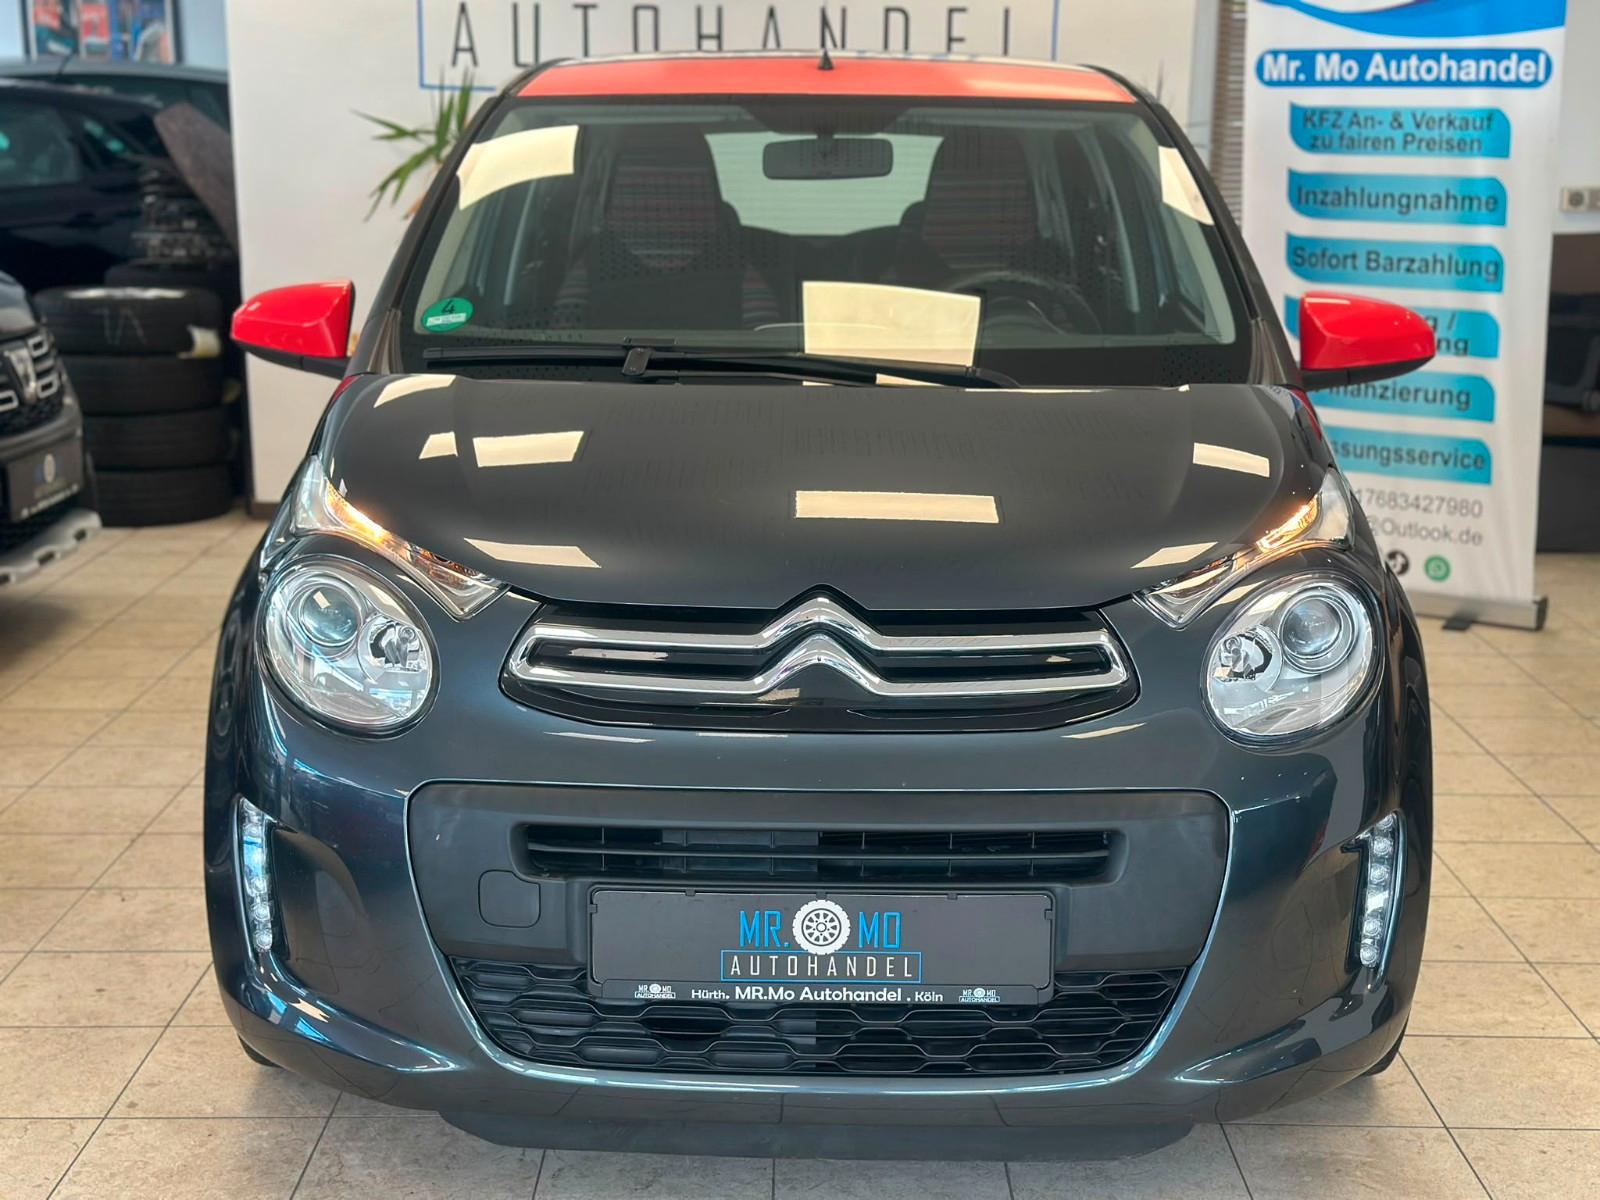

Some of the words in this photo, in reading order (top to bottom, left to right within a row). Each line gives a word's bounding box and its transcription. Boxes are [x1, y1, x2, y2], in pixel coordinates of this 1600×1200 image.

[1262, 53, 1305, 82] Mr.
[1314, 53, 1360, 82] Mo
[1365, 52, 1547, 82] Autohandel
[1303, 111, 1344, 130] KFZ
[1349, 112, 1383, 131] An-
[1390, 112, 1404, 131] &
[1411, 111, 1494, 132] Verkauf
[1310, 136, 1333, 150] zu
[1338, 131, 1396, 151] fairen
[1402, 132, 1483, 153] Preisen
[1297, 185, 1499, 215] Inzahlungnahme
[1292, 246, 1359, 271] Sofort
[1364, 250, 1501, 283] Barzahlung
[441, 300, 455, 313] 4
[1353, 487, 1484, 519] 17683427980
[739, 910, 790, 948] MR.
[858, 911, 901, 948] MO
[730, 955, 913, 977] AUTOHANDEL
[735, 986, 795, 1000] MR.Mo
[800, 986, 902, 1001] Autohandel
[914, 990, 944, 1002] Köln
